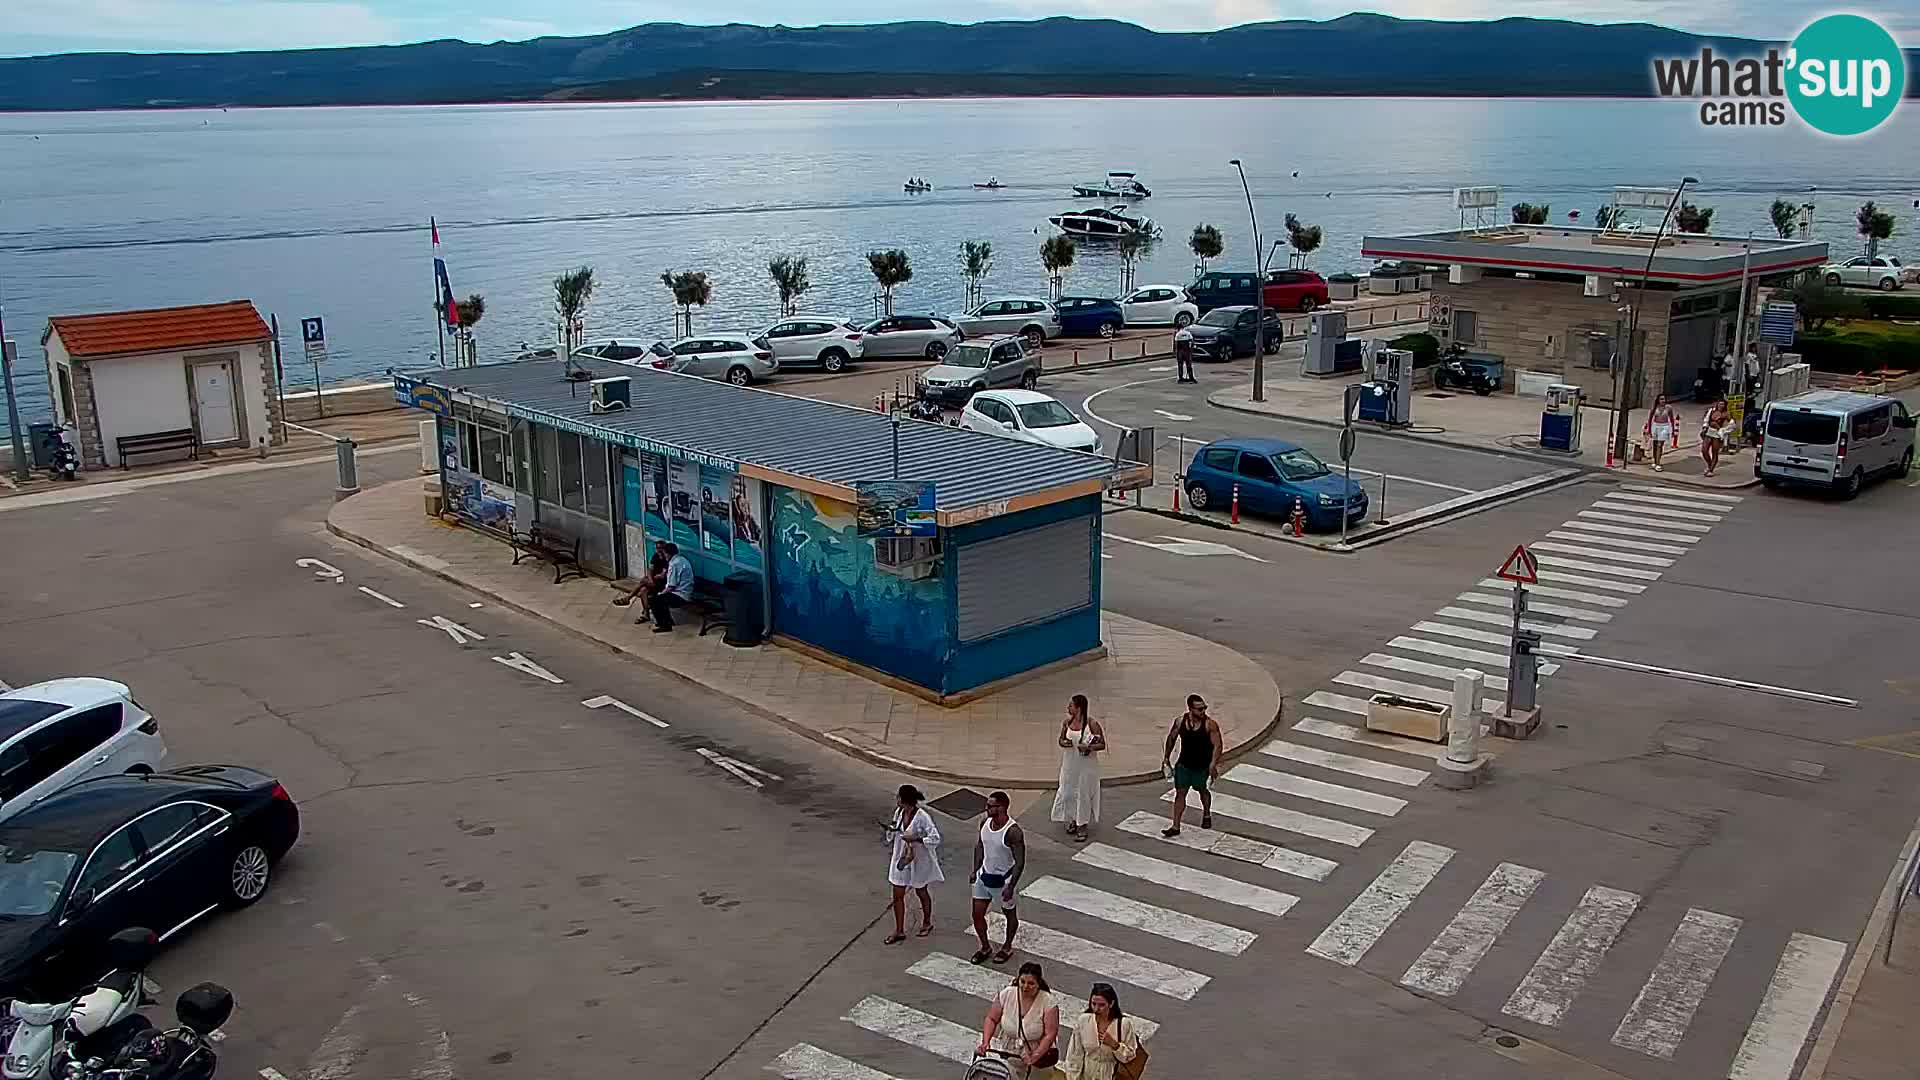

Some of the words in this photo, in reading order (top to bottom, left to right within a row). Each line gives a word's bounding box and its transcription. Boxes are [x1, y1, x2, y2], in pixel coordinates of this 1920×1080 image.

[308, 322, 318, 338] P
[595, 428, 625, 444] POSTAJA
[634, 438, 648, 449] BUS
[650, 442, 681, 457] STATION
[683, 450, 708, 464] TICKET
[709, 457, 735, 471] OFFICE
